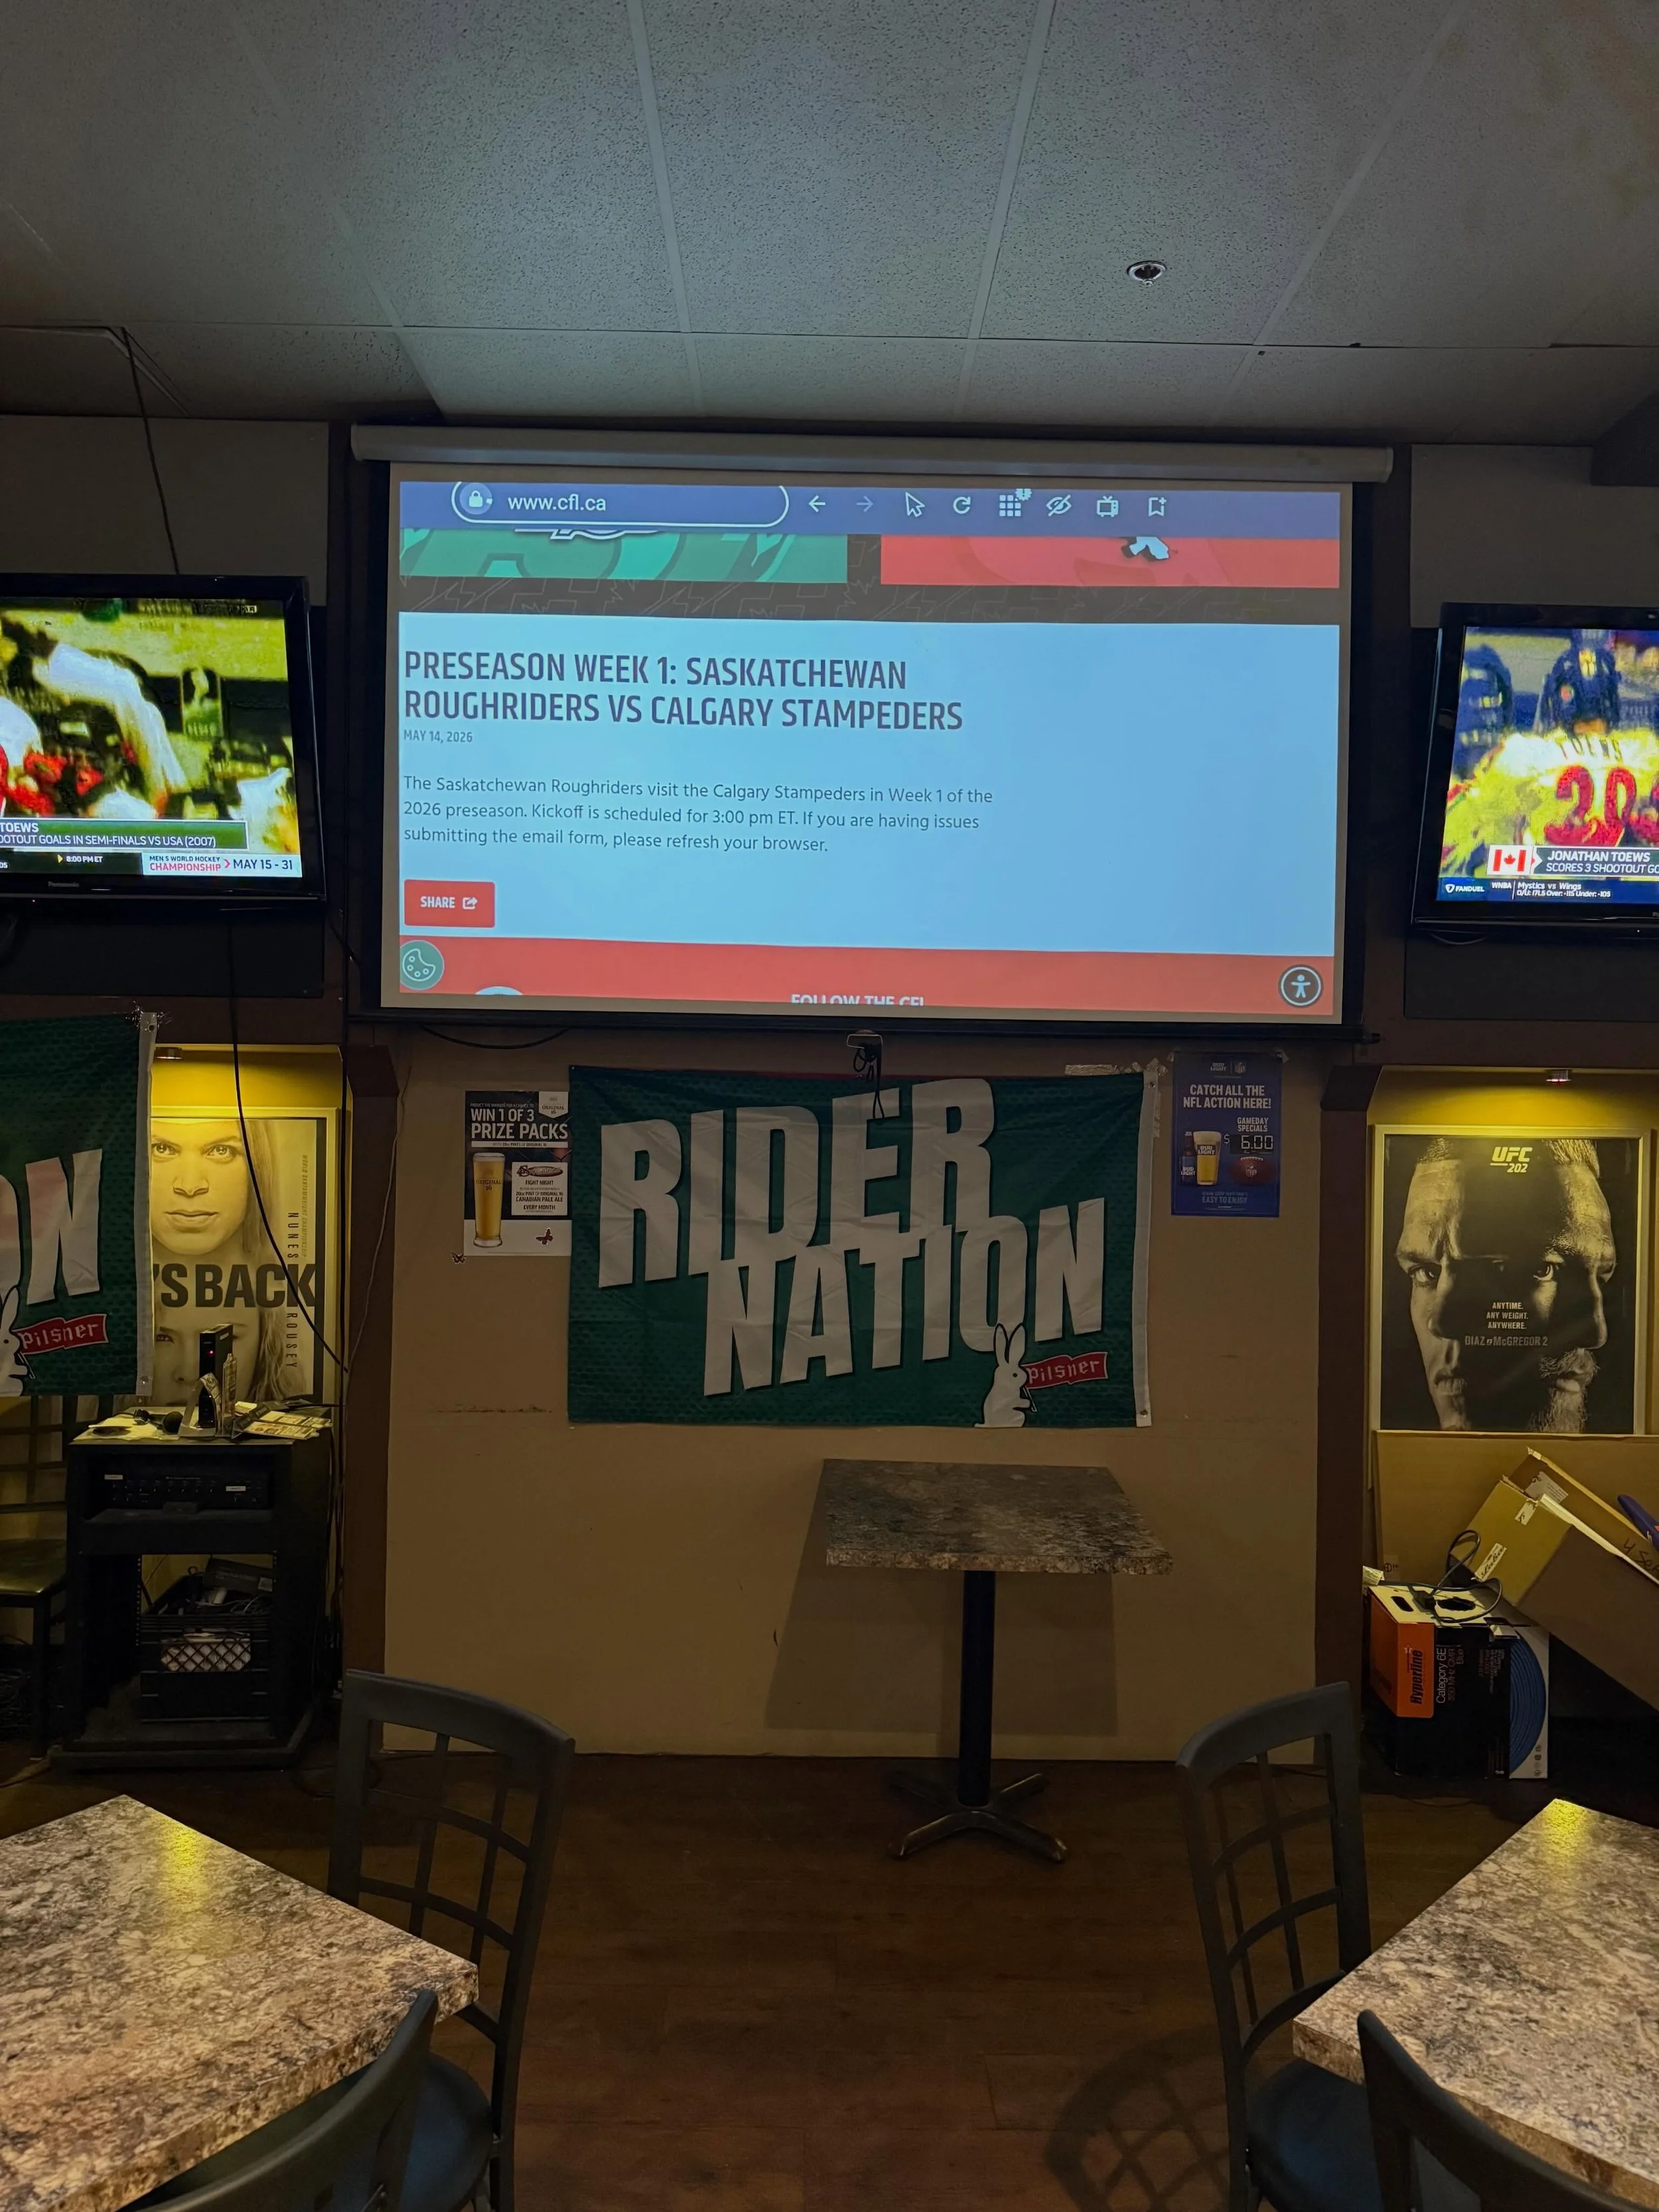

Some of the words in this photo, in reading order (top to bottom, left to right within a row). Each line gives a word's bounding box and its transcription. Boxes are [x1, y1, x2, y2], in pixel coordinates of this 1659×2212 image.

[508, 494, 607, 512] www.cfl.ca
[405, 650, 564, 682] PRESEASON
[575, 654, 649, 684] WEEK
[657, 656, 676, 684] 1:
[687, 657, 905, 689] SASKATCHEWAN
[405, 690, 599, 721] ROUGHRIDERS
[608, 694, 643, 723] VS
[651, 696, 773, 727] CALGARY
[781, 699, 963, 731] STAMPEDERS
[403, 729, 425, 742] MAY
[429, 730, 444, 744] 14,
[447, 731, 472, 743] 2026
[403, 775, 431, 791] The
[437, 777, 546, 793] Saskatchewan
[551, 778, 642, 798] Roughriders
[648, 782, 679, 796] visit
[684, 783, 708, 798] the
[713, 784, 770, 802] Calgary
[775, 785, 865, 802] Stampeders
[871, 787, 883, 802] in
[889, 787, 932, 802] Week
[936, 789, 943, 802] 1
[947, 788, 964, 803] of
[968, 789, 993, 804] the
[403, 802, 441, 816] 2026
[446, 804, 527, 821] preseason.
[532, 804, 583, 819] Kickoff
[589, 806, 599, 820] is
[604, 806, 681, 823] scheduled
[687, 808, 708, 823] for
[713, 810, 745, 824] 3:00
[749, 814, 772, 828] pm
[778, 811, 798, 826] ET.
[804, 811, 814, 826] If
[818, 816, 845, 830] you
[850, 816, 873, 827] are
[879, 813, 929, 831] having
[934, 814, 979, 829] issues
[0, 822, 39, 833] TOEWS
[39, 835, 71, 844] GOALS
[73, 836, 84, 844] IN
[86, 836, 146, 845] SEMI-FINALS
[148, 836, 161, 846] VS
[163, 837, 183, 846] USA
[185, 836, 216, 848] (2007)
[404, 828, 487, 846] submitting
[492, 829, 518, 844] the
[522, 829, 563, 844] email
[568, 830, 609, 848] form,
[613, 832, 662, 849] please
[666, 835, 719, 849] refresh
[724, 838, 758, 852] your
[763, 836, 828, 852] browser.
[233, 859, 257, 869] MAY
[261, 859, 271, 869] 15
[282, 860, 292, 869] 31
[1548, 851, 1609, 861] JONATHAN
[1611, 851, 1650, 862] TOEWS
[150, 863, 221, 871] CHAMPIONSHIP
[1546, 863, 1583, 872] SCORES
[1585, 863, 1591, 872] 3
[1593, 863, 1646, 873] SHOOTOUT
[1518, 882, 1546, 891] Mystics
[1559, 883, 1581, 891] Wings
[420, 896, 455, 909] SHARE
[1190, 1084, 1225, 1096] CATCH
[1226, 1085, 1244, 1096] ALL
[1246, 1085, 1265, 1096] THE
[1183, 1096, 1202, 1108] NFL
[1204, 1097, 1242, 1108] ACTION
[1243, 1098, 1271, 1109] HERE!
[470, 1108, 495, 1122] WIN
[498, 1109, 504, 1122] 1
[508, 1109, 524, 1122] OF
[527, 1109, 534, 1122] 3
[471, 1123, 515, 1140] PRIZE
[520, 1123, 569, 1140] PACKS
[1224, 1134, 1230, 1145] $
[1241, 1135, 1273, 1149] 6.00
[1492, 1147, 1532, 1163] UFC
[1508, 1163, 1528, 1173] 202
[599, 1078, 995, 1288] RIDER
[287, 1212, 299, 1259] NUNES
[195, 1264, 315, 1308] BACK
[704, 1197, 1106, 1396] NATION
[1502, 1311, 1529, 1320] WEIGHT.
[20, 1321, 99, 1350] Pilsner
[286, 1312, 298, 1368] ROUSEY
[1465, 1335, 1485, 1346] DIAZ
[1493, 1336, 1541, 1346] McGREGOR
[1542, 1336, 1548, 1347] 2
[1027, 1359, 1102, 1388] Pilsner
[1436, 1648, 1447, 1661] 6E
[1409, 1650, 1423, 1704] Hyperline
[1436, 1662, 1448, 1704] Category
